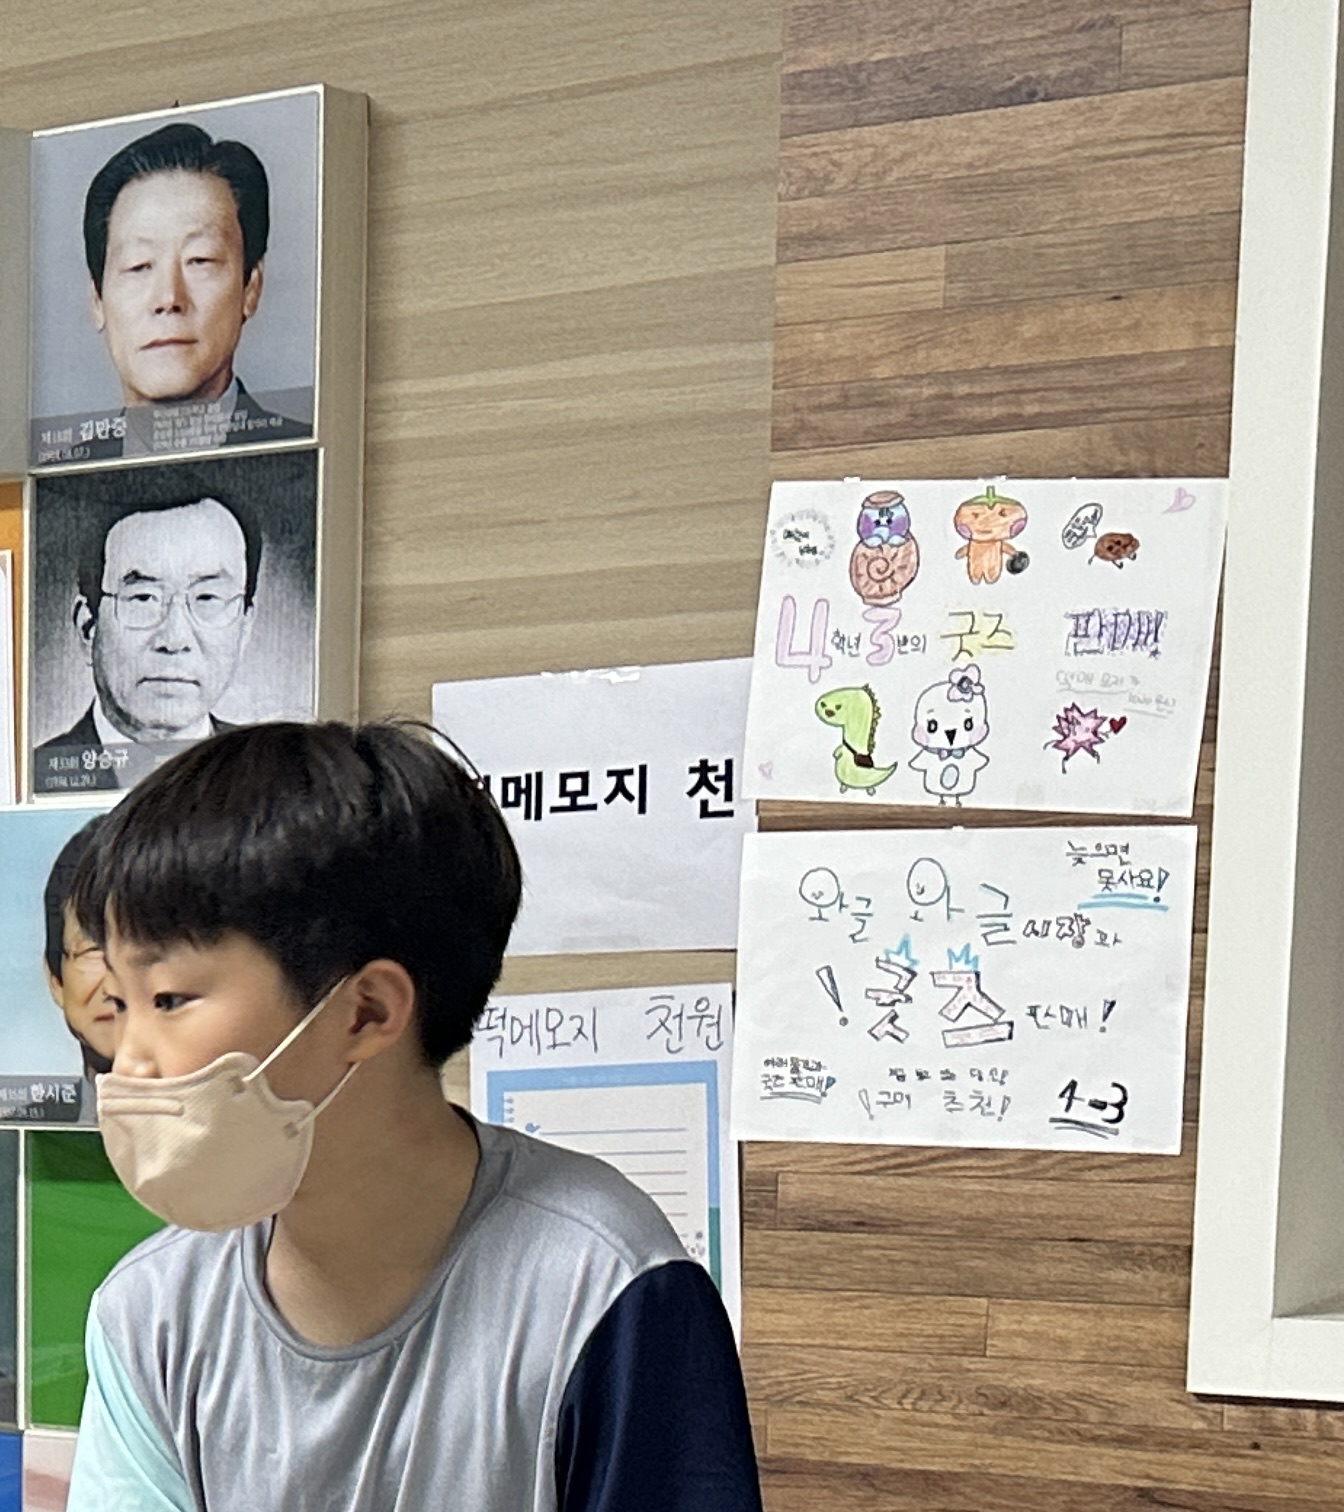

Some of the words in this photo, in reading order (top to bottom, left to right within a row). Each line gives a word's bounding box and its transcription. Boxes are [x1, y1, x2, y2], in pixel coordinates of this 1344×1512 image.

[941, 610, 1015, 661] 굿즈
[480, 763, 648, 822] 메모지
[474, 1006, 599, 1059] 떡메모지
[645, 995, 725, 1052] 천원
